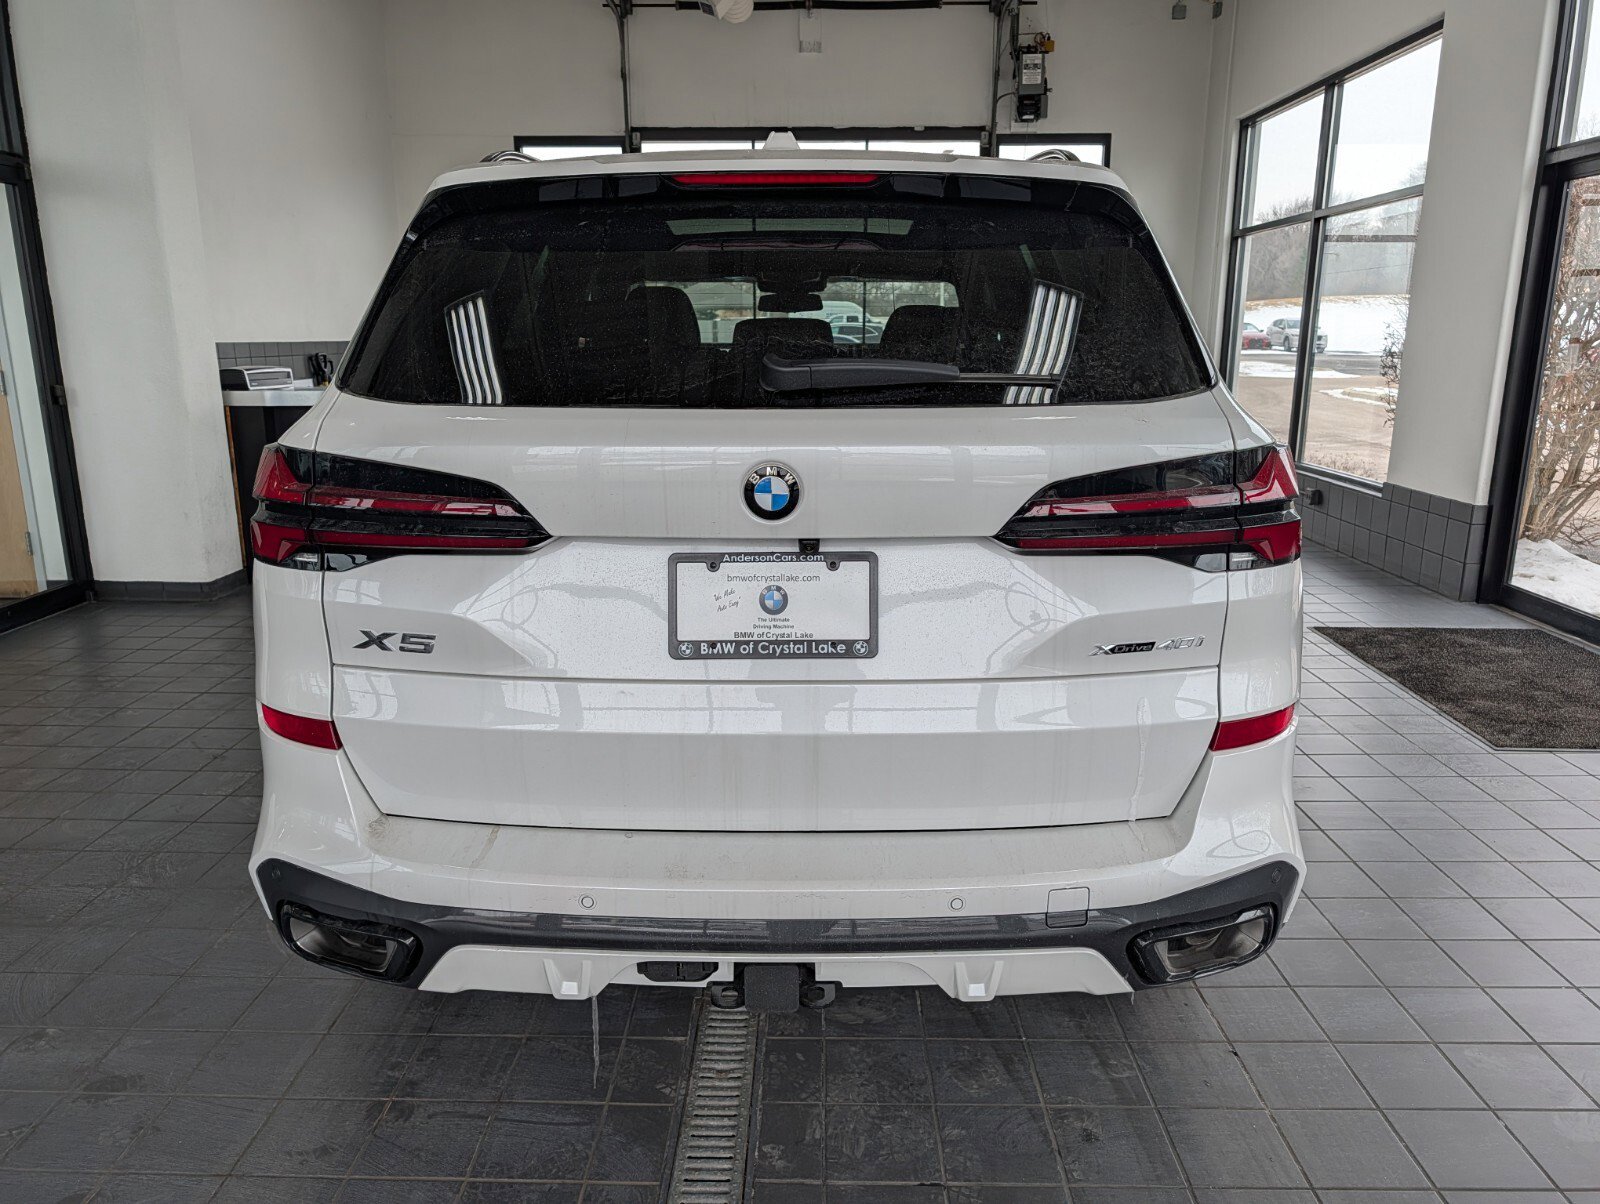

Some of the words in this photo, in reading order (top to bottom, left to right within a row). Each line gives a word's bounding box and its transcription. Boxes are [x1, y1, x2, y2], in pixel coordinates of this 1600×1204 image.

[748, 466, 796, 485] BMW
[722, 554, 824, 562] AndersonCars.com
[727, 574, 821, 584] bmwofcrystallake.com
[352, 629, 437, 654] X5
[765, 632, 793, 640] Crystal
[1156, 635, 1206, 650] 40i
[740, 642, 754, 654] of
[757, 642, 808, 656] Crystal
[812, 642, 846, 654] Lake
